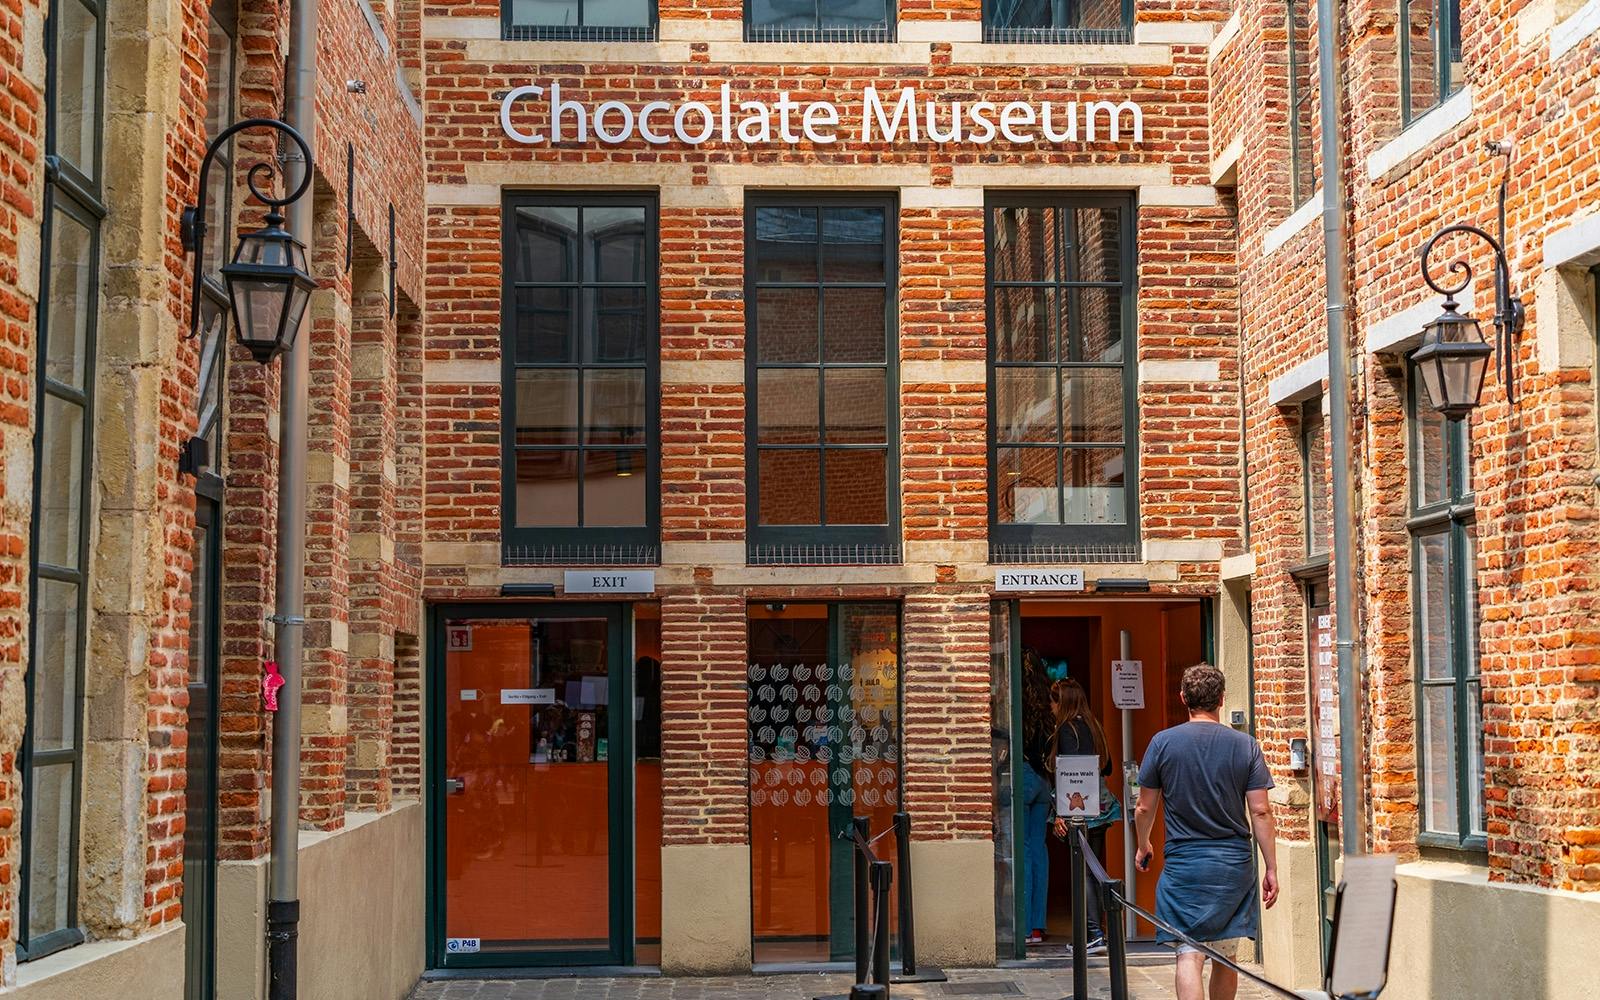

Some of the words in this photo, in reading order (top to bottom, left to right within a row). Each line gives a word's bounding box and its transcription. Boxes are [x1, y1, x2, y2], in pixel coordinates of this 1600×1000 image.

[500, 84, 839, 144] Chocolate
[861, 86, 1144, 144] Museum
[592, 576, 627, 588] EXIT
[1001, 574, 1079, 586] ENTRANCE
